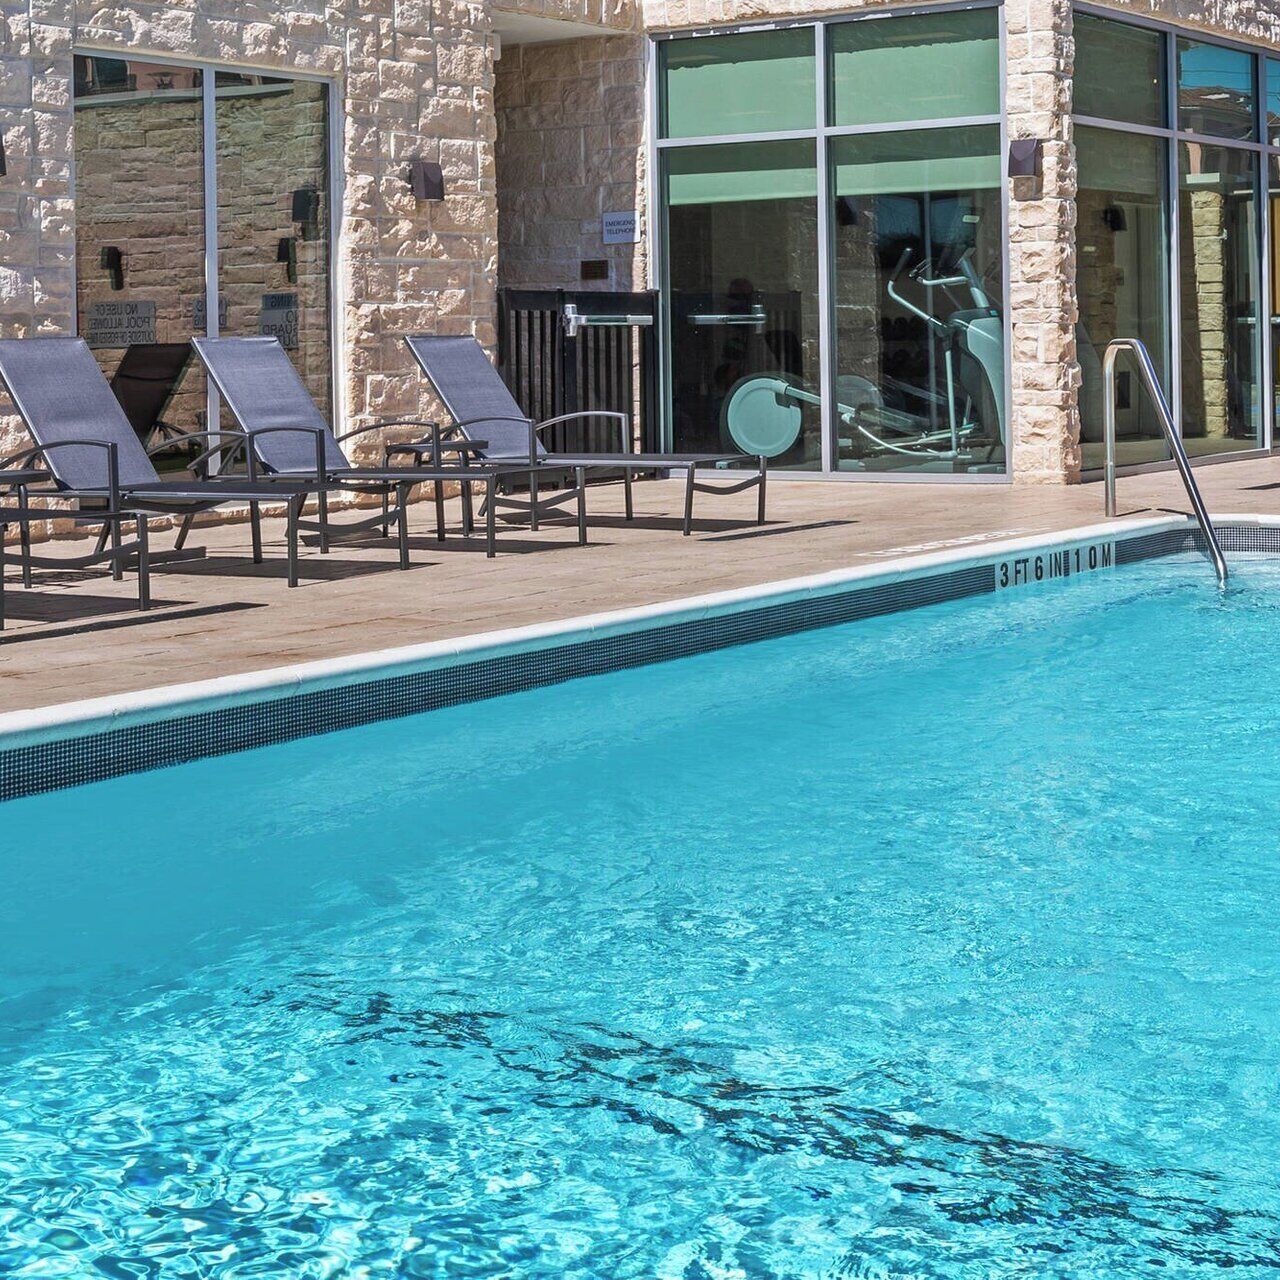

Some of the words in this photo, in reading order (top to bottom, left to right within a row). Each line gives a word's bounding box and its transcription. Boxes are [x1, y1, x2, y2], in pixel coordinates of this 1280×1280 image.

[604, 218, 636, 228] EMERGENC
[606, 226, 636, 235] TELEPHON
[1000, 562, 1009, 588] 3
[1014, 558, 1029, 585] FT
[1034, 556, 1043, 581] 6
[1049, 552, 1062, 578] IN
[1102, 543, 1111, 568] M
